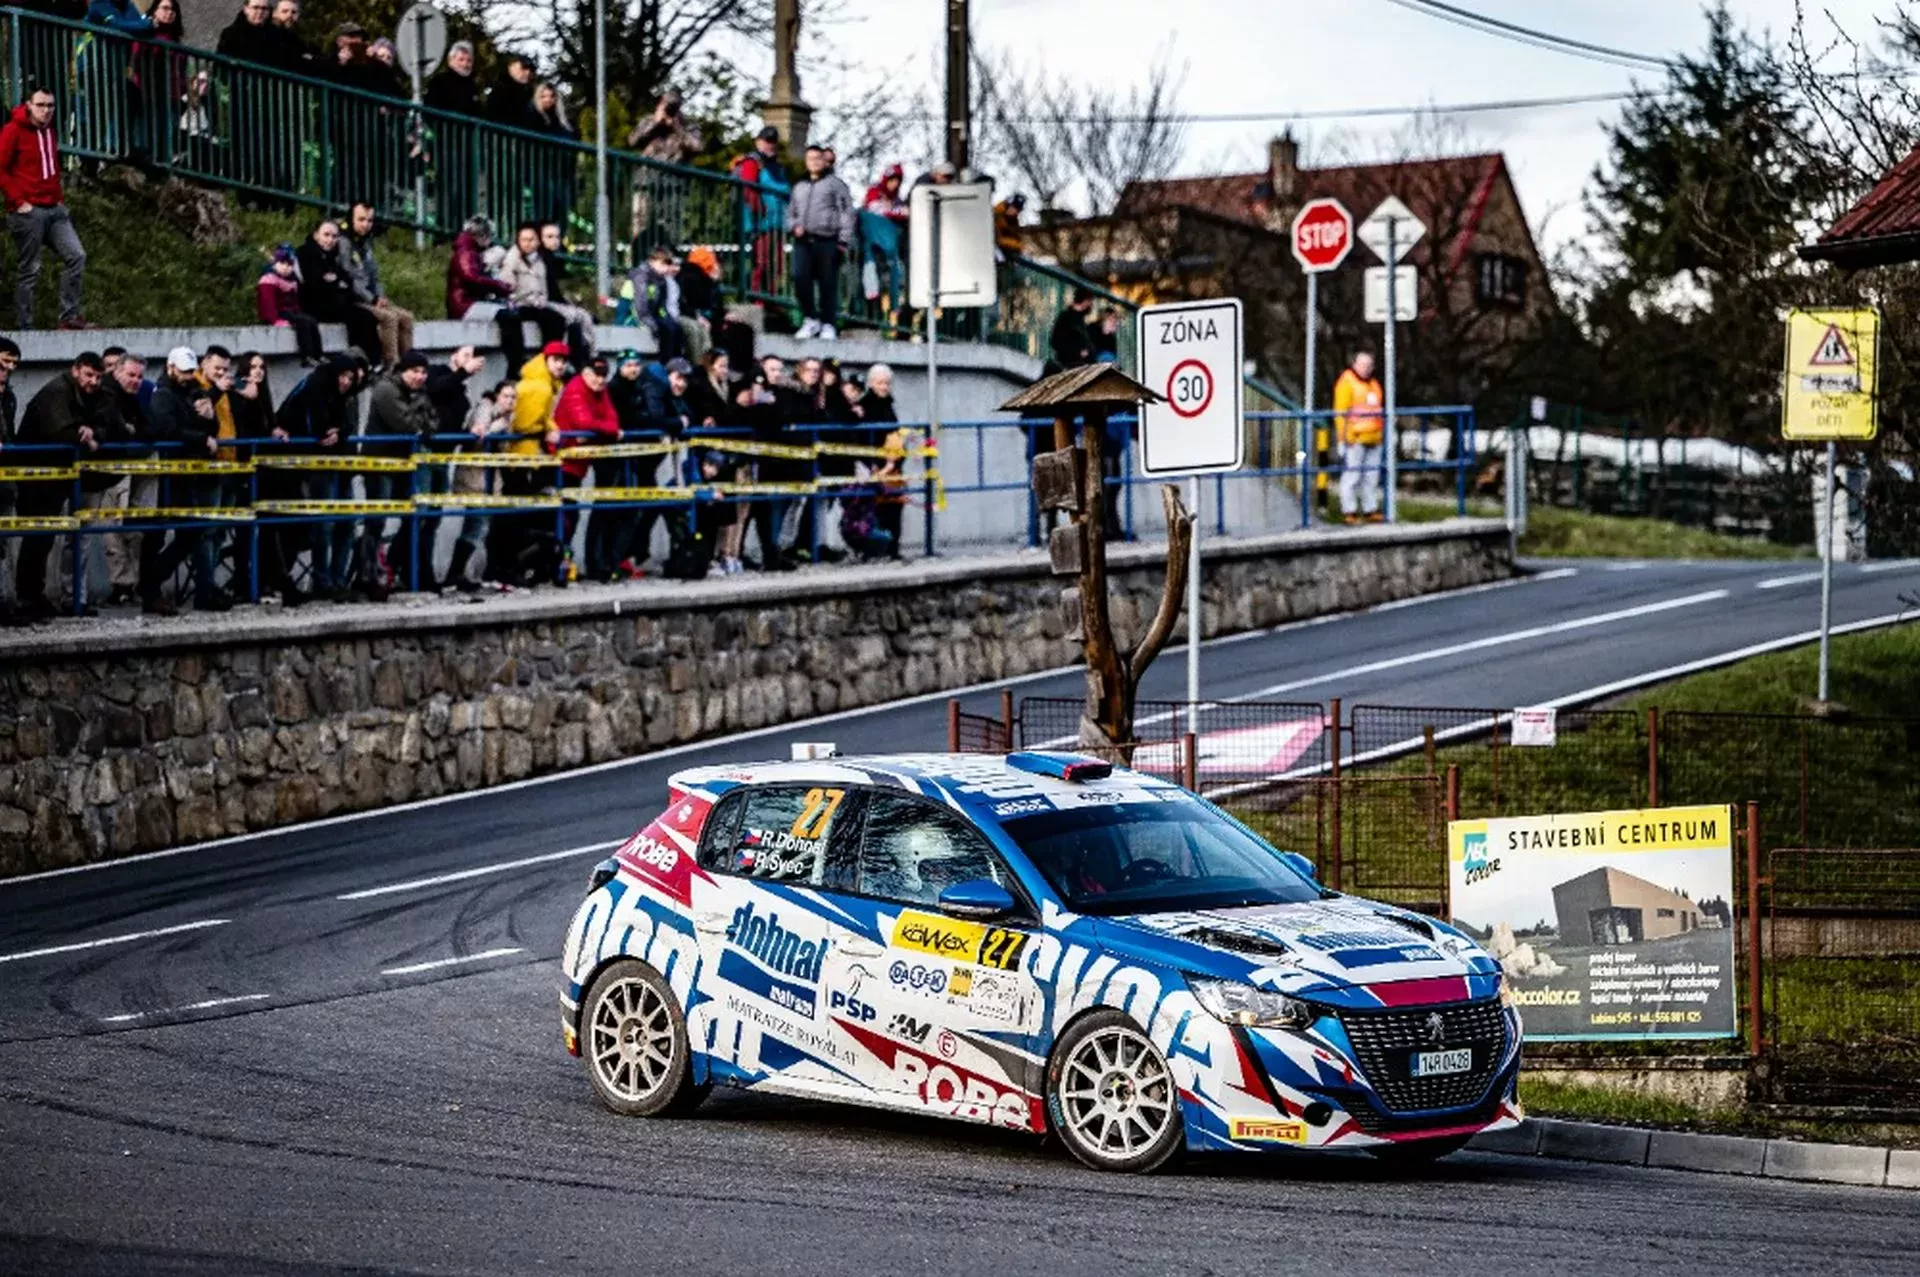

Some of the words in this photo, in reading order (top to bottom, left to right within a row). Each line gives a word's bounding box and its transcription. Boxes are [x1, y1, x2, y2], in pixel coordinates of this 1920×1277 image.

[1299, 220, 1347, 252] STOP
[1160, 315, 1219, 345] ZÓNA
[1177, 375, 1204, 403] 30
[791, 786, 845, 840] 27
[1508, 821, 1605, 850] STAVEBNÍ
[1618, 819, 1716, 845] CENTRUM
[982, 929, 1023, 969] 27
[831, 990, 877, 1023] PSP
[1236, 1120, 1302, 1141] PIRELLI
